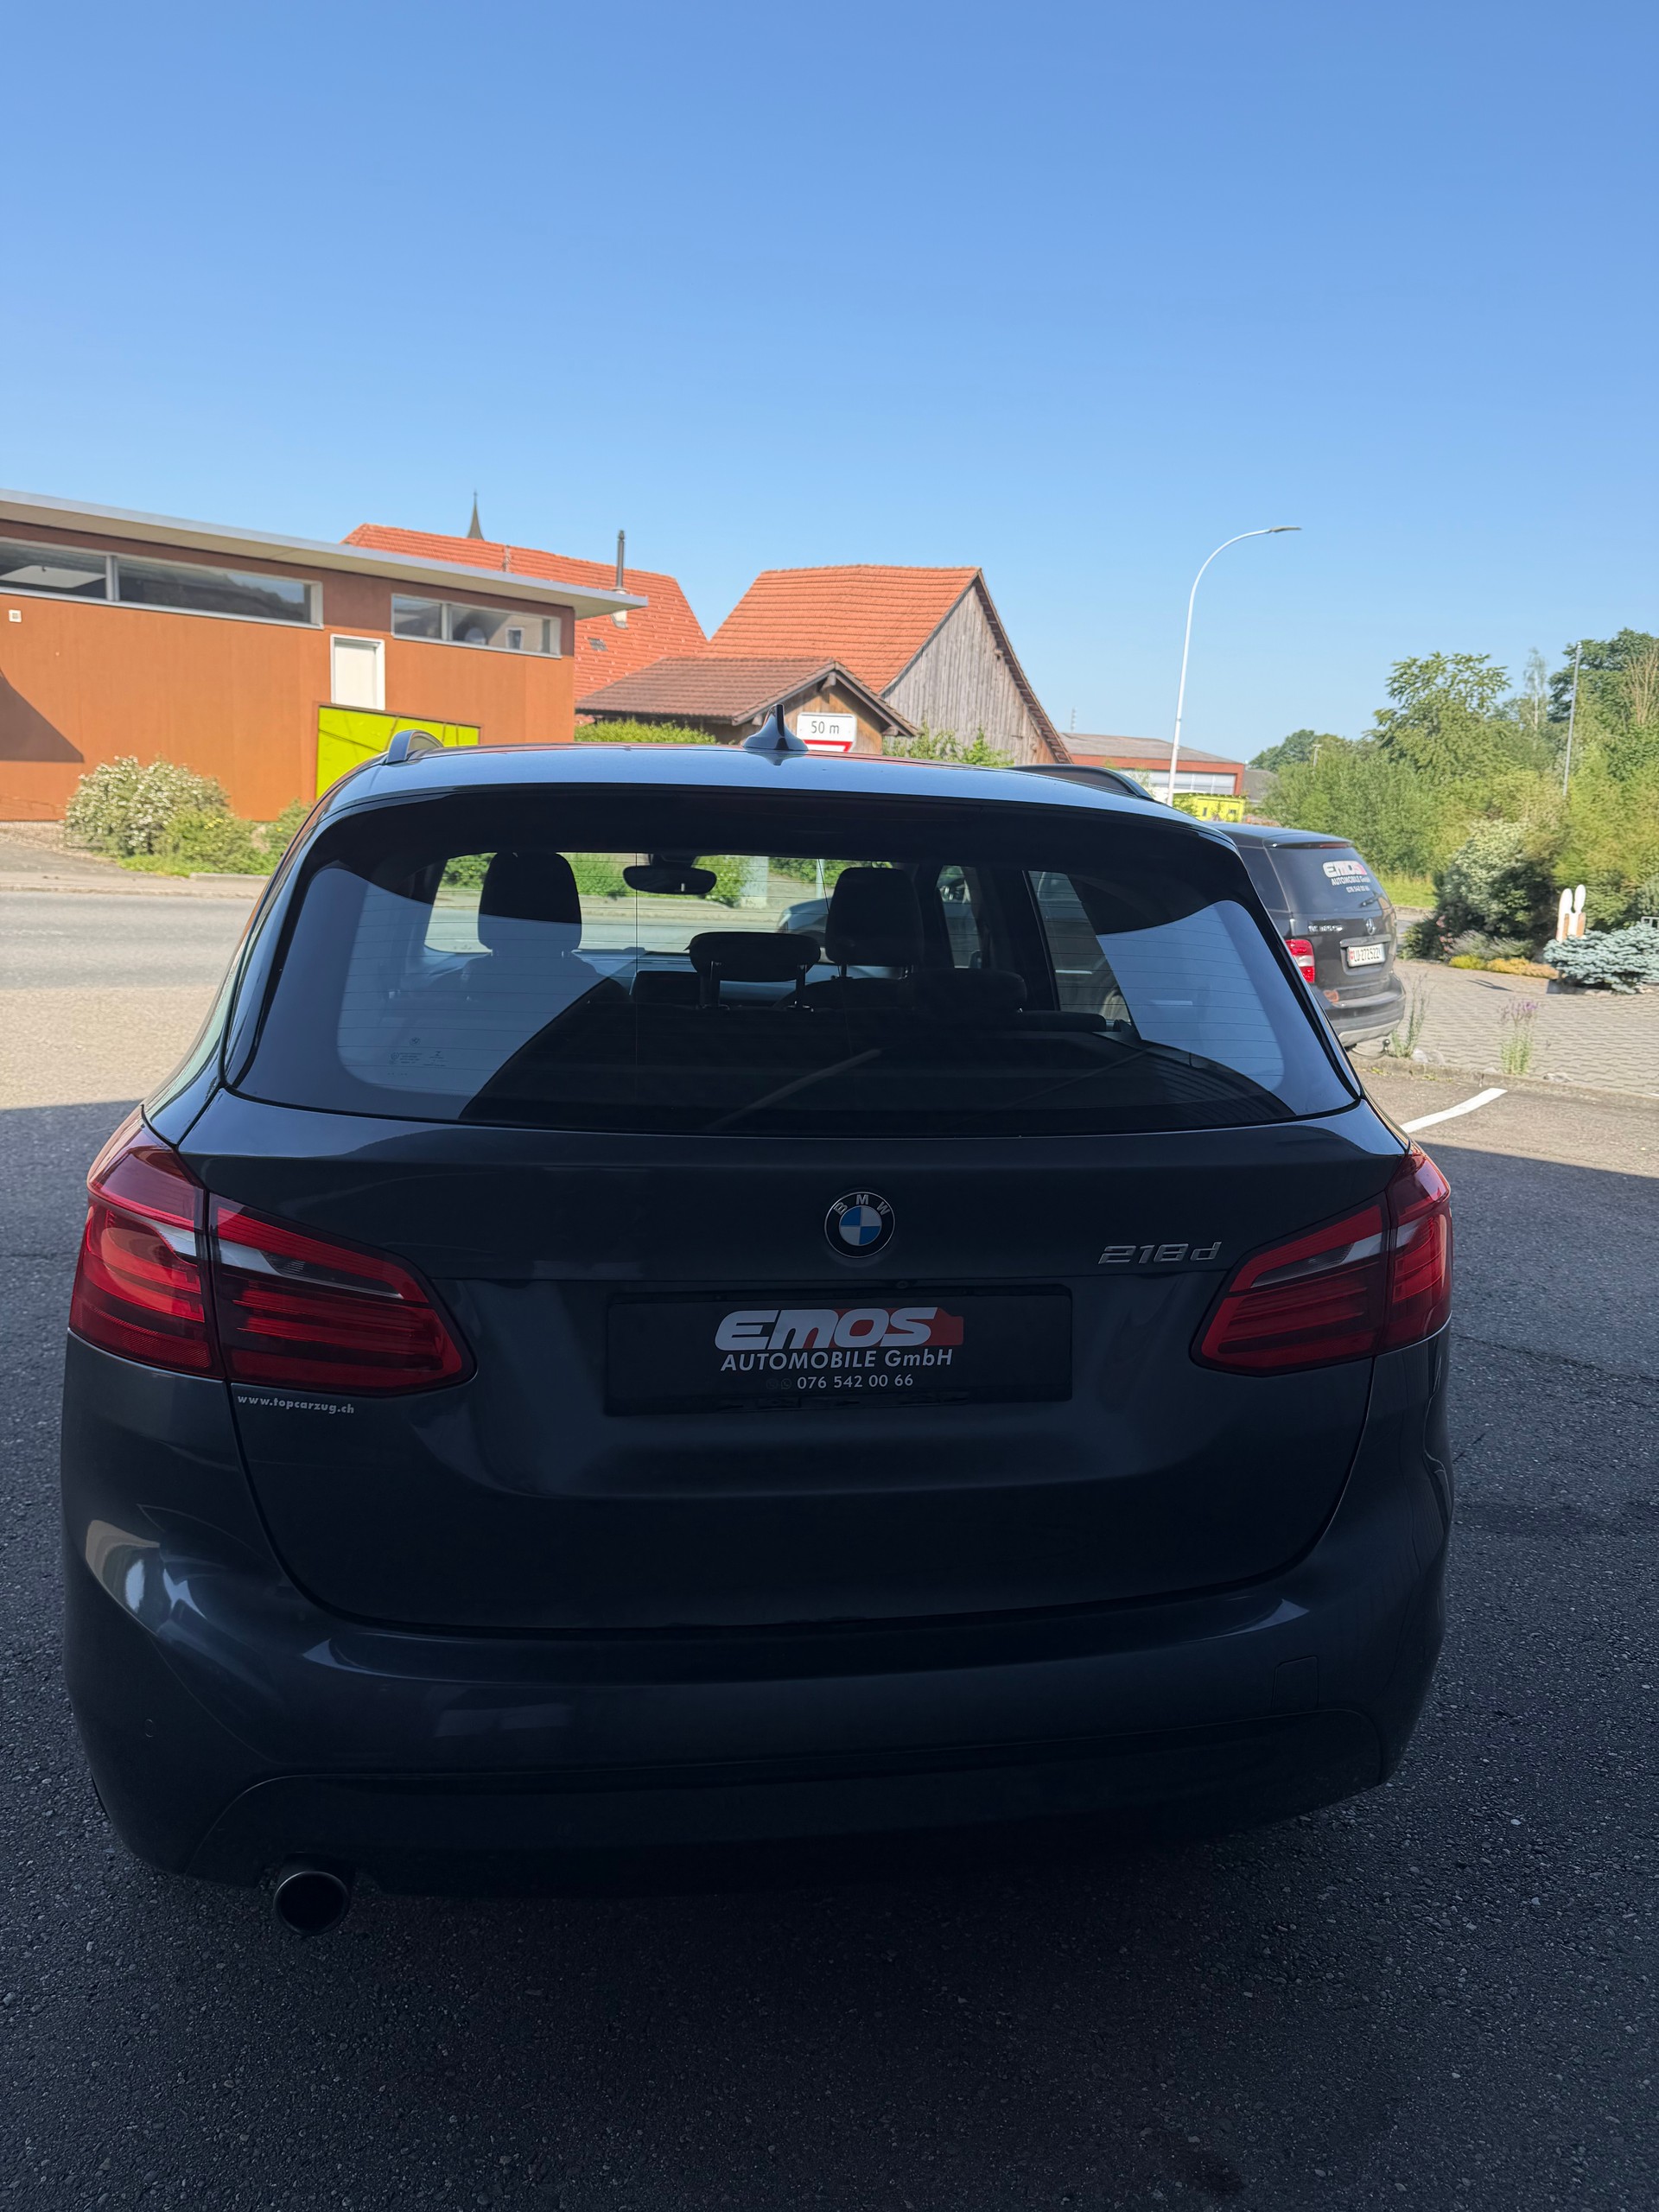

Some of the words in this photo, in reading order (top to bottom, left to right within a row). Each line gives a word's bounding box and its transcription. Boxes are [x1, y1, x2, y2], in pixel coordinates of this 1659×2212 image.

[811, 721, 825, 734] 50
[830, 725, 839, 734] m
[833, 1194, 891, 1216] BMW
[1098, 1241, 1222, 1264] 218d
[720, 1350, 876, 1371] AUTOMOBILE
[884, 1348, 953, 1367] GmbH
[797, 1376, 827, 1389] 076
[834, 1375, 863, 1389] 542
[868, 1374, 888, 1388] 00
[894, 1373, 913, 1387] 66
[238, 1395, 355, 1414] www.topcarzug.ch
